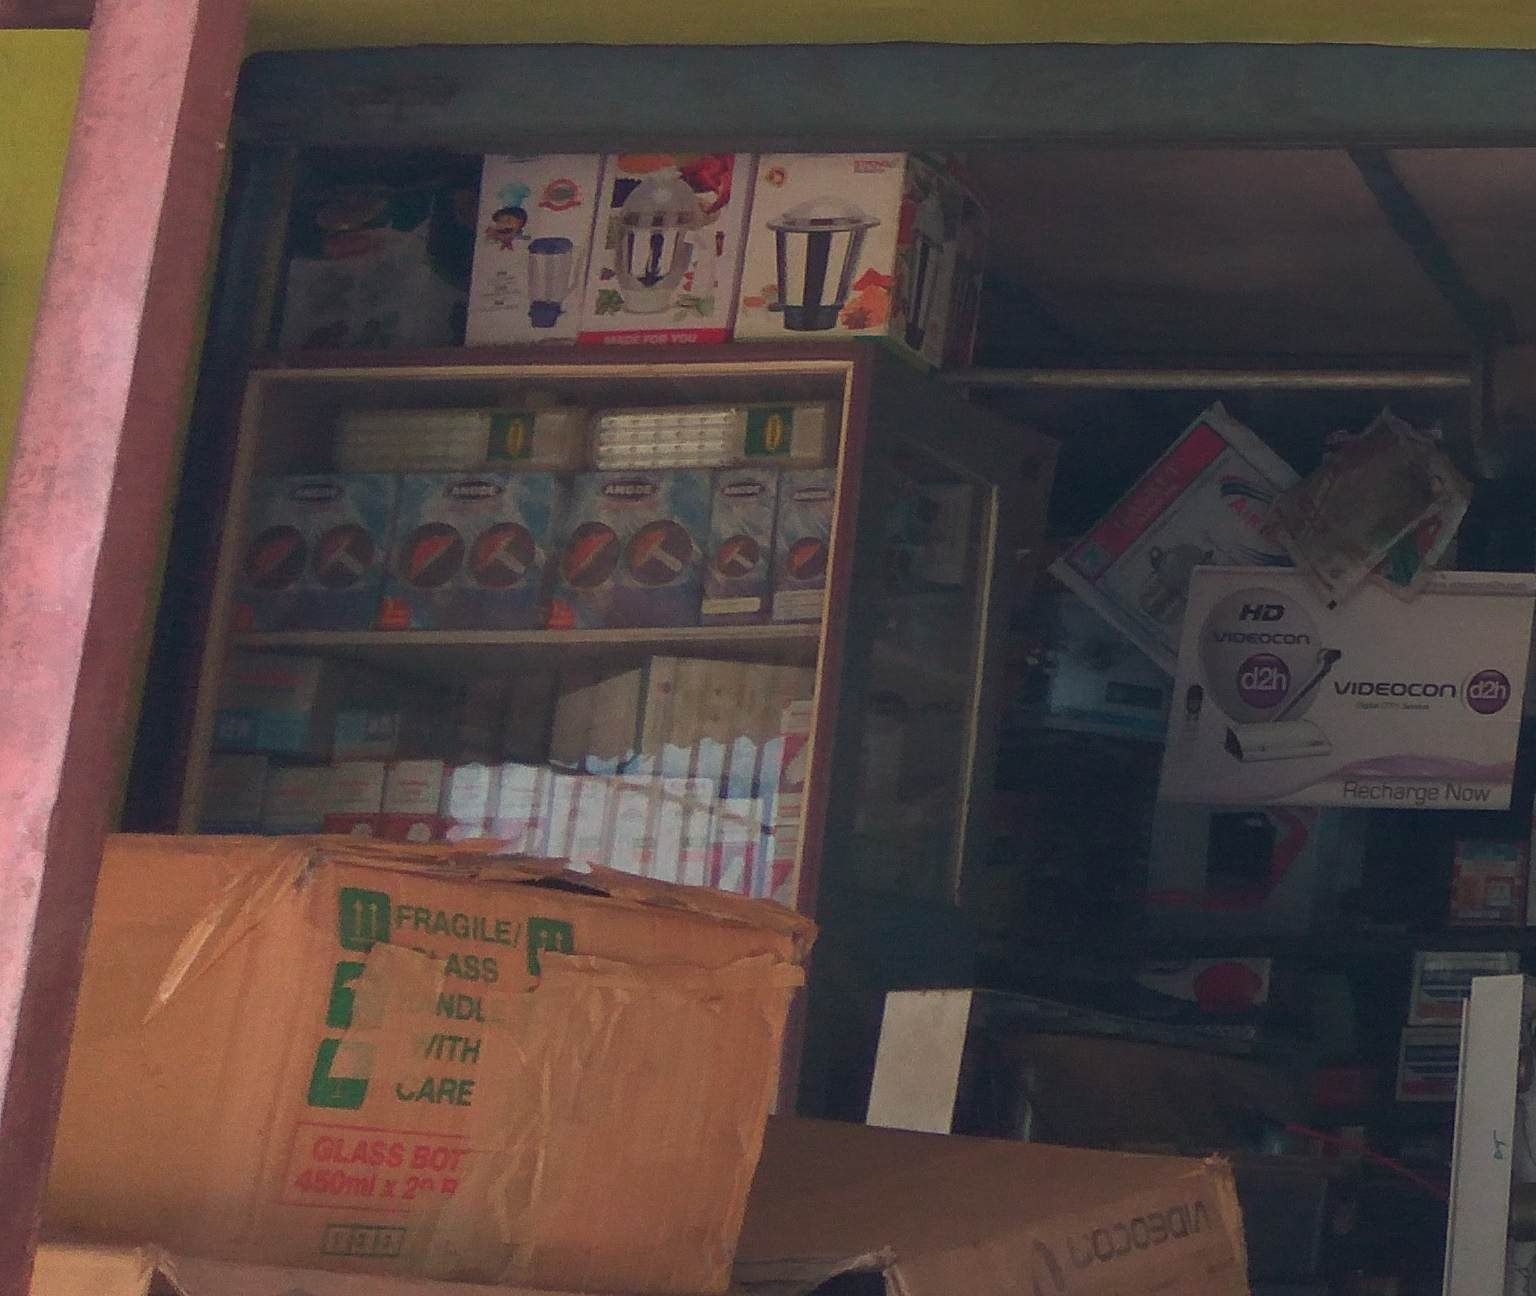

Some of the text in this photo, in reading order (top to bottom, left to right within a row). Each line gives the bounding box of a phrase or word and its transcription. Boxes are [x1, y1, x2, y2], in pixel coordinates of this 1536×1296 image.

[1238, 603, 1286, 622] HD
[1240, 666, 1288, 692] d2h
[1469, 679, 1507, 701] d2h
[1343, 782, 1491, 805] Recharge Now
[423, 1033, 482, 1064] ITH
[312, 1135, 404, 1169] GLASS
